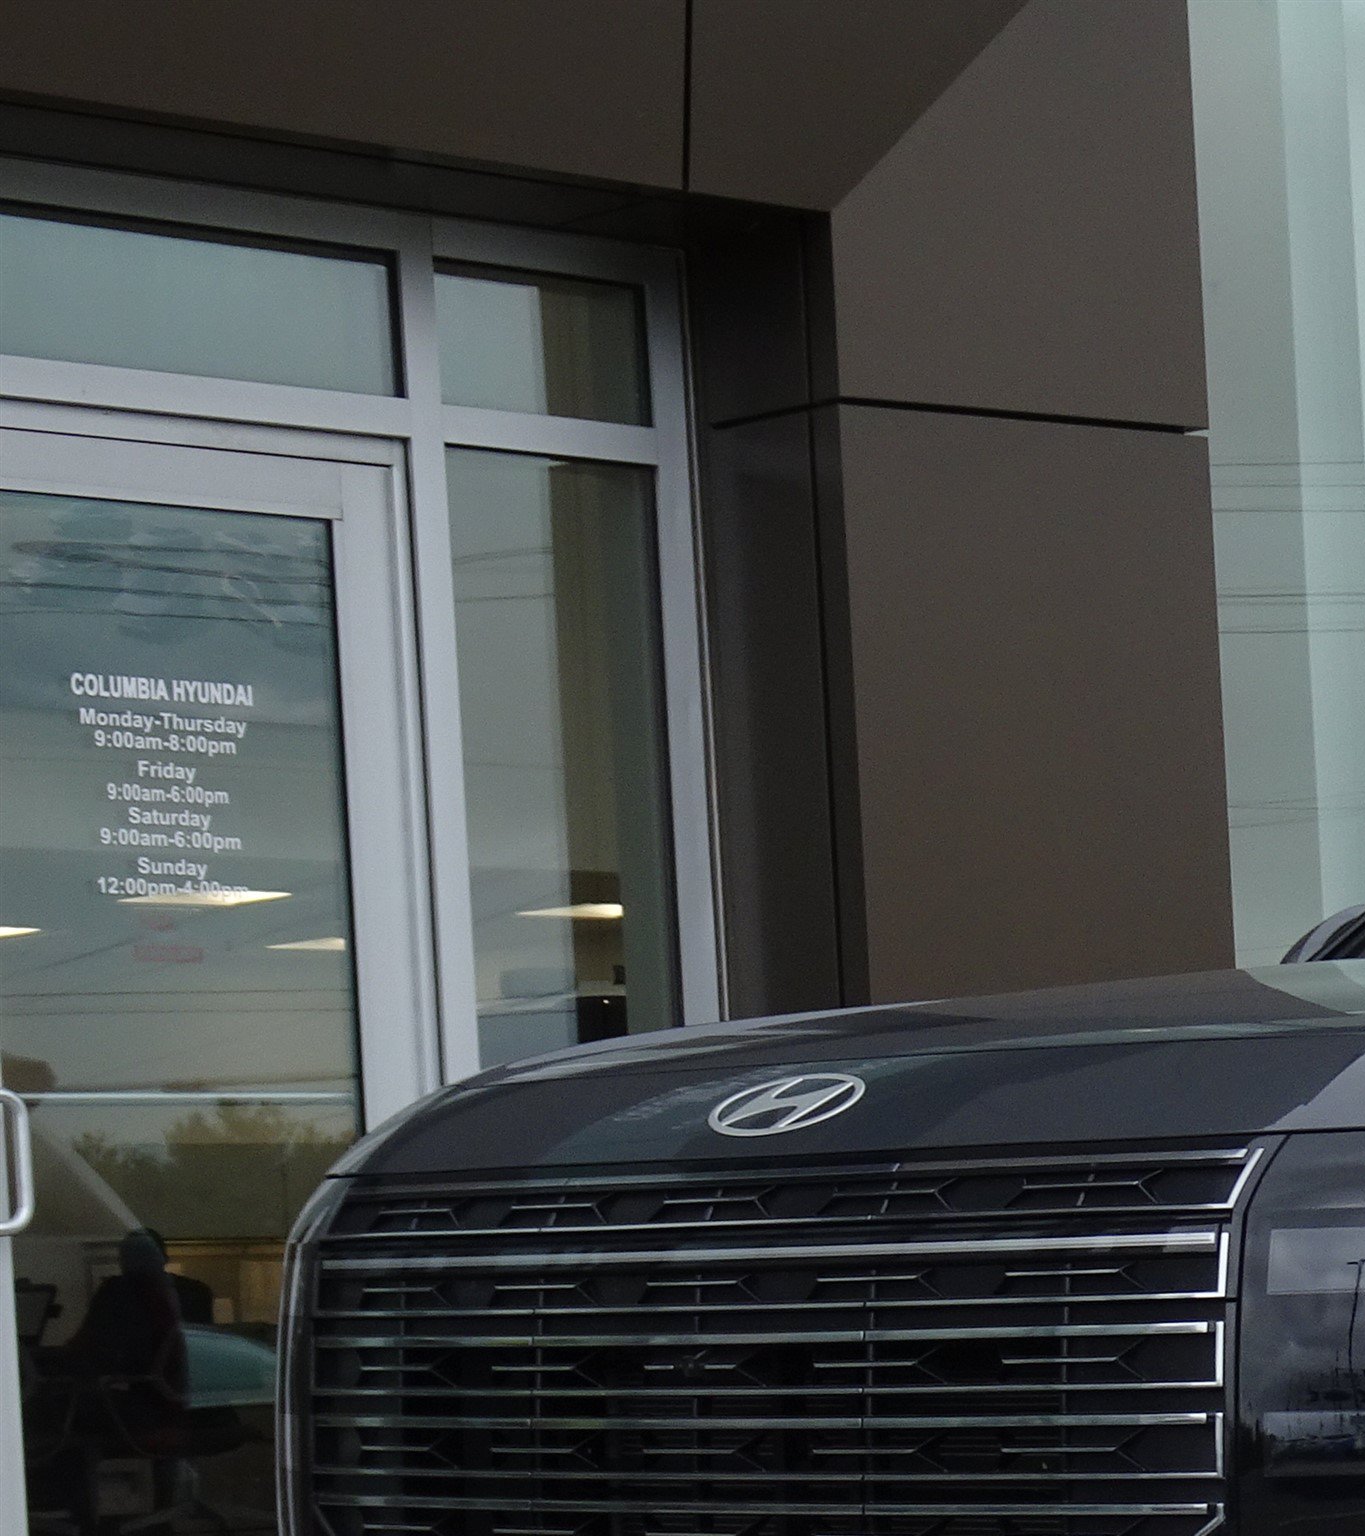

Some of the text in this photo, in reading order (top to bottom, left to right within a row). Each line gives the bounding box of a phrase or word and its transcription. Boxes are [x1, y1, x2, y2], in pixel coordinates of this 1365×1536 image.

[70, 672, 254, 706] COLUMBIA HYUNDAI
[79, 707, 247, 738] Monday-Thursday
[94, 730, 237, 757] 9:00am-8:00pm
[137, 760, 197, 784] Friday
[107, 782, 230, 807] 9:00am-6:00pm
[128, 806, 212, 831] Saturday
[100, 827, 242, 853] 9:00am-6:00pm
[137, 856, 208, 880] Sunday
